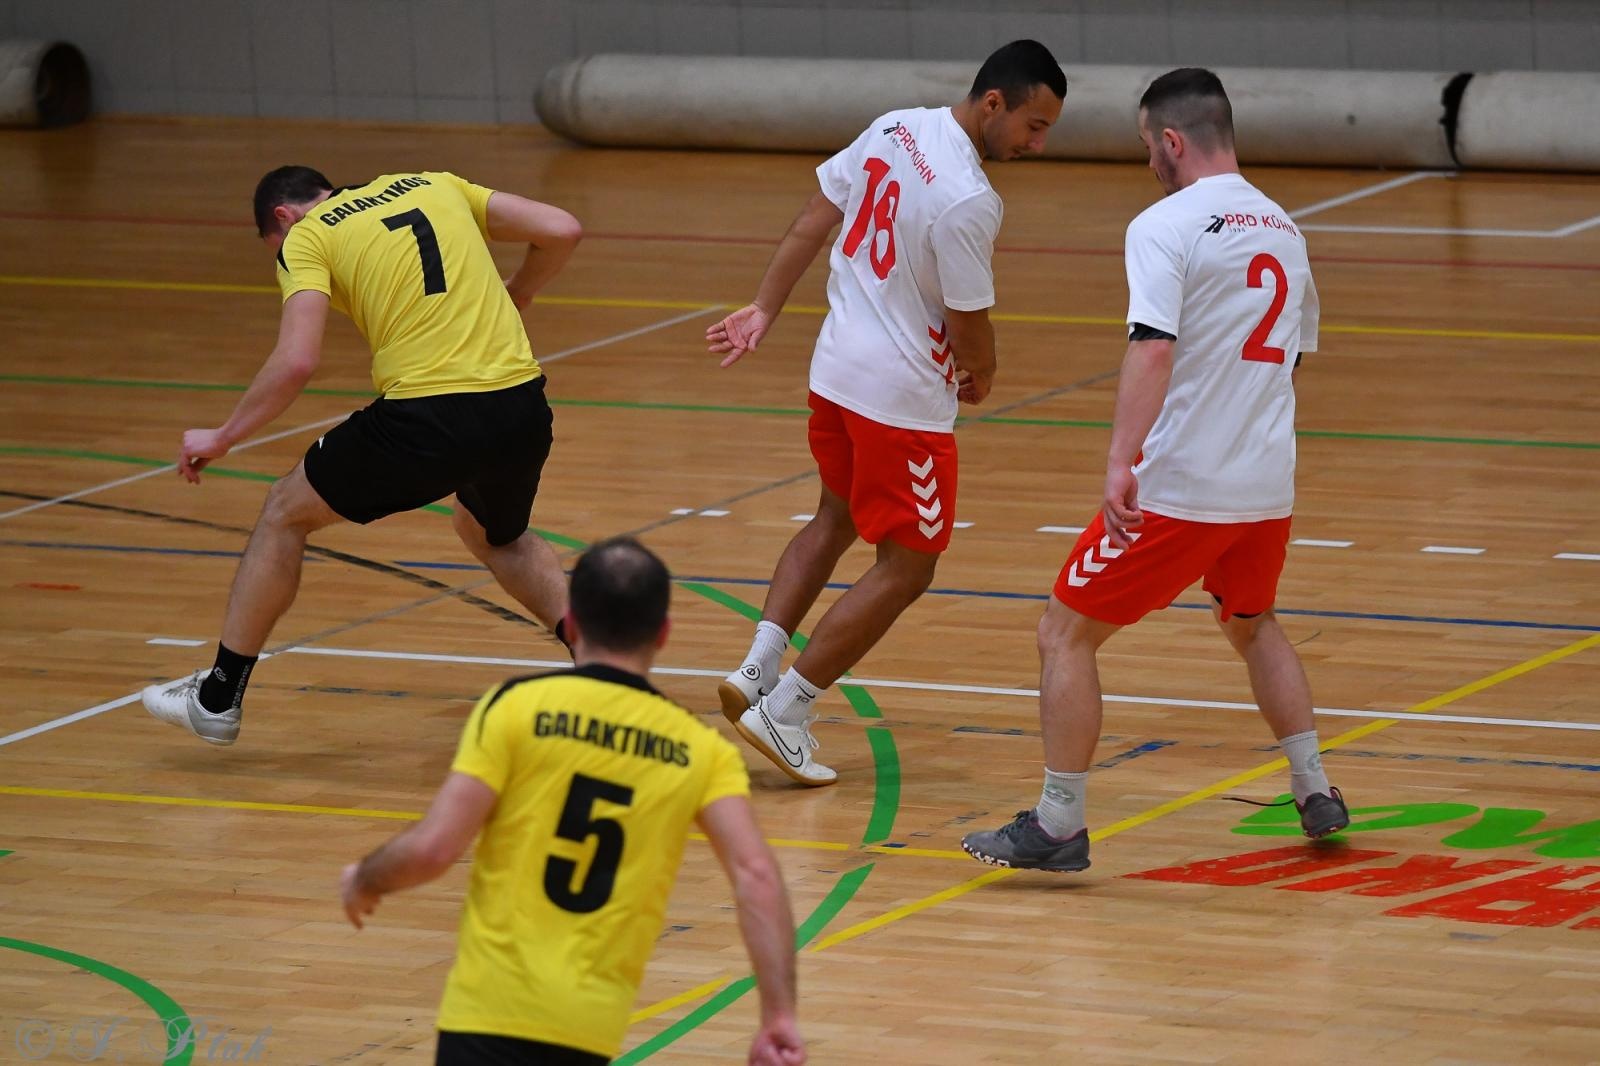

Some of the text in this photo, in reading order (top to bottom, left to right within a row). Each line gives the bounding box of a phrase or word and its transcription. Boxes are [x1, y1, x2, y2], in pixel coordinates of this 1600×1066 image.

[320, 177, 432, 226] GALAKTIKOS
[381, 208, 447, 296] 7
[1241, 253, 1289, 364] 2
[534, 711, 690, 768] GALAKTIKOS
[543, 772, 635, 914] 5
